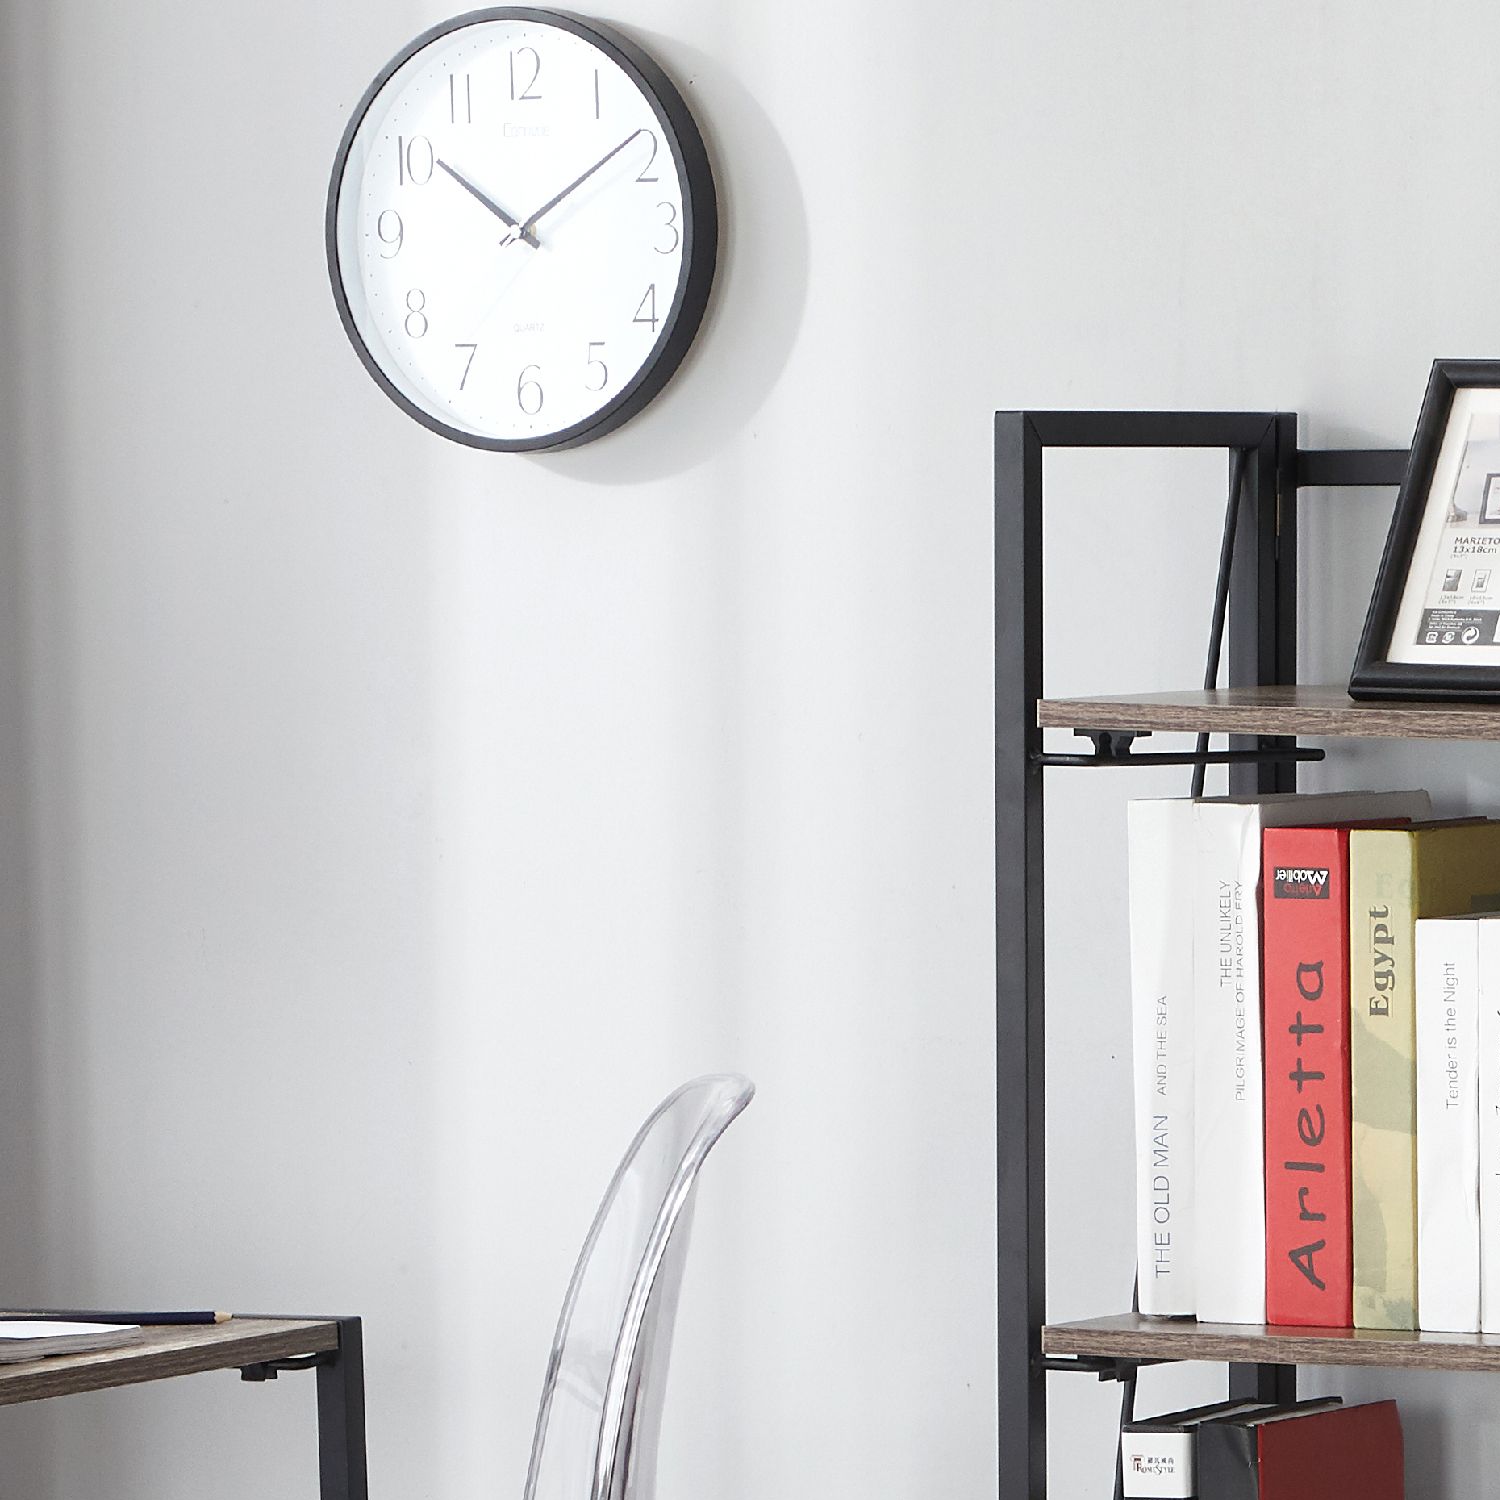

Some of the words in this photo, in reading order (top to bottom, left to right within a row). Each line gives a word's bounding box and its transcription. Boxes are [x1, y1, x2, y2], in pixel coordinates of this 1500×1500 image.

[449, 73, 472, 124] 11
[510, 46, 543, 101] 12
[594, 68, 600, 120] 1
[397, 135, 434, 187] 10
[636, 128, 660, 183] 2
[377, 209, 404, 260] 9
[653, 201, 680, 255] 3
[404, 288, 429, 339] 8
[632, 283, 660, 333] 4
[454, 343, 478, 391] 7
[516, 364, 544, 416] 6
[585, 341, 609, 392] 5
[1219, 879, 1232, 954] UNLIKELY
[1234, 879, 1244, 911] FRY
[1234, 914, 1245, 978] HAROLD
[1368, 903, 1396, 1018] Egypt
[1219, 957, 1232, 988] THE
[1234, 981, 1245, 1004] OF
[1443, 961, 1458, 1003] Night
[1156, 995, 1168, 1027] SEA
[1444, 1007, 1457, 1032] the
[1156, 1029, 1168, 1061] THE
[1234, 1007, 1246, 1102] PILGRIMAGE
[1446, 1036, 1458, 1049] is
[1156, 1064, 1168, 1096] AND
[1445, 1052, 1459, 1110] Tender
[1152, 1115, 1170, 1167] MAN
[1284, 959, 1326, 1292] Arletta
[1152, 1175, 1171, 1224] OLD
[1152, 1232, 1171, 1279] THE
